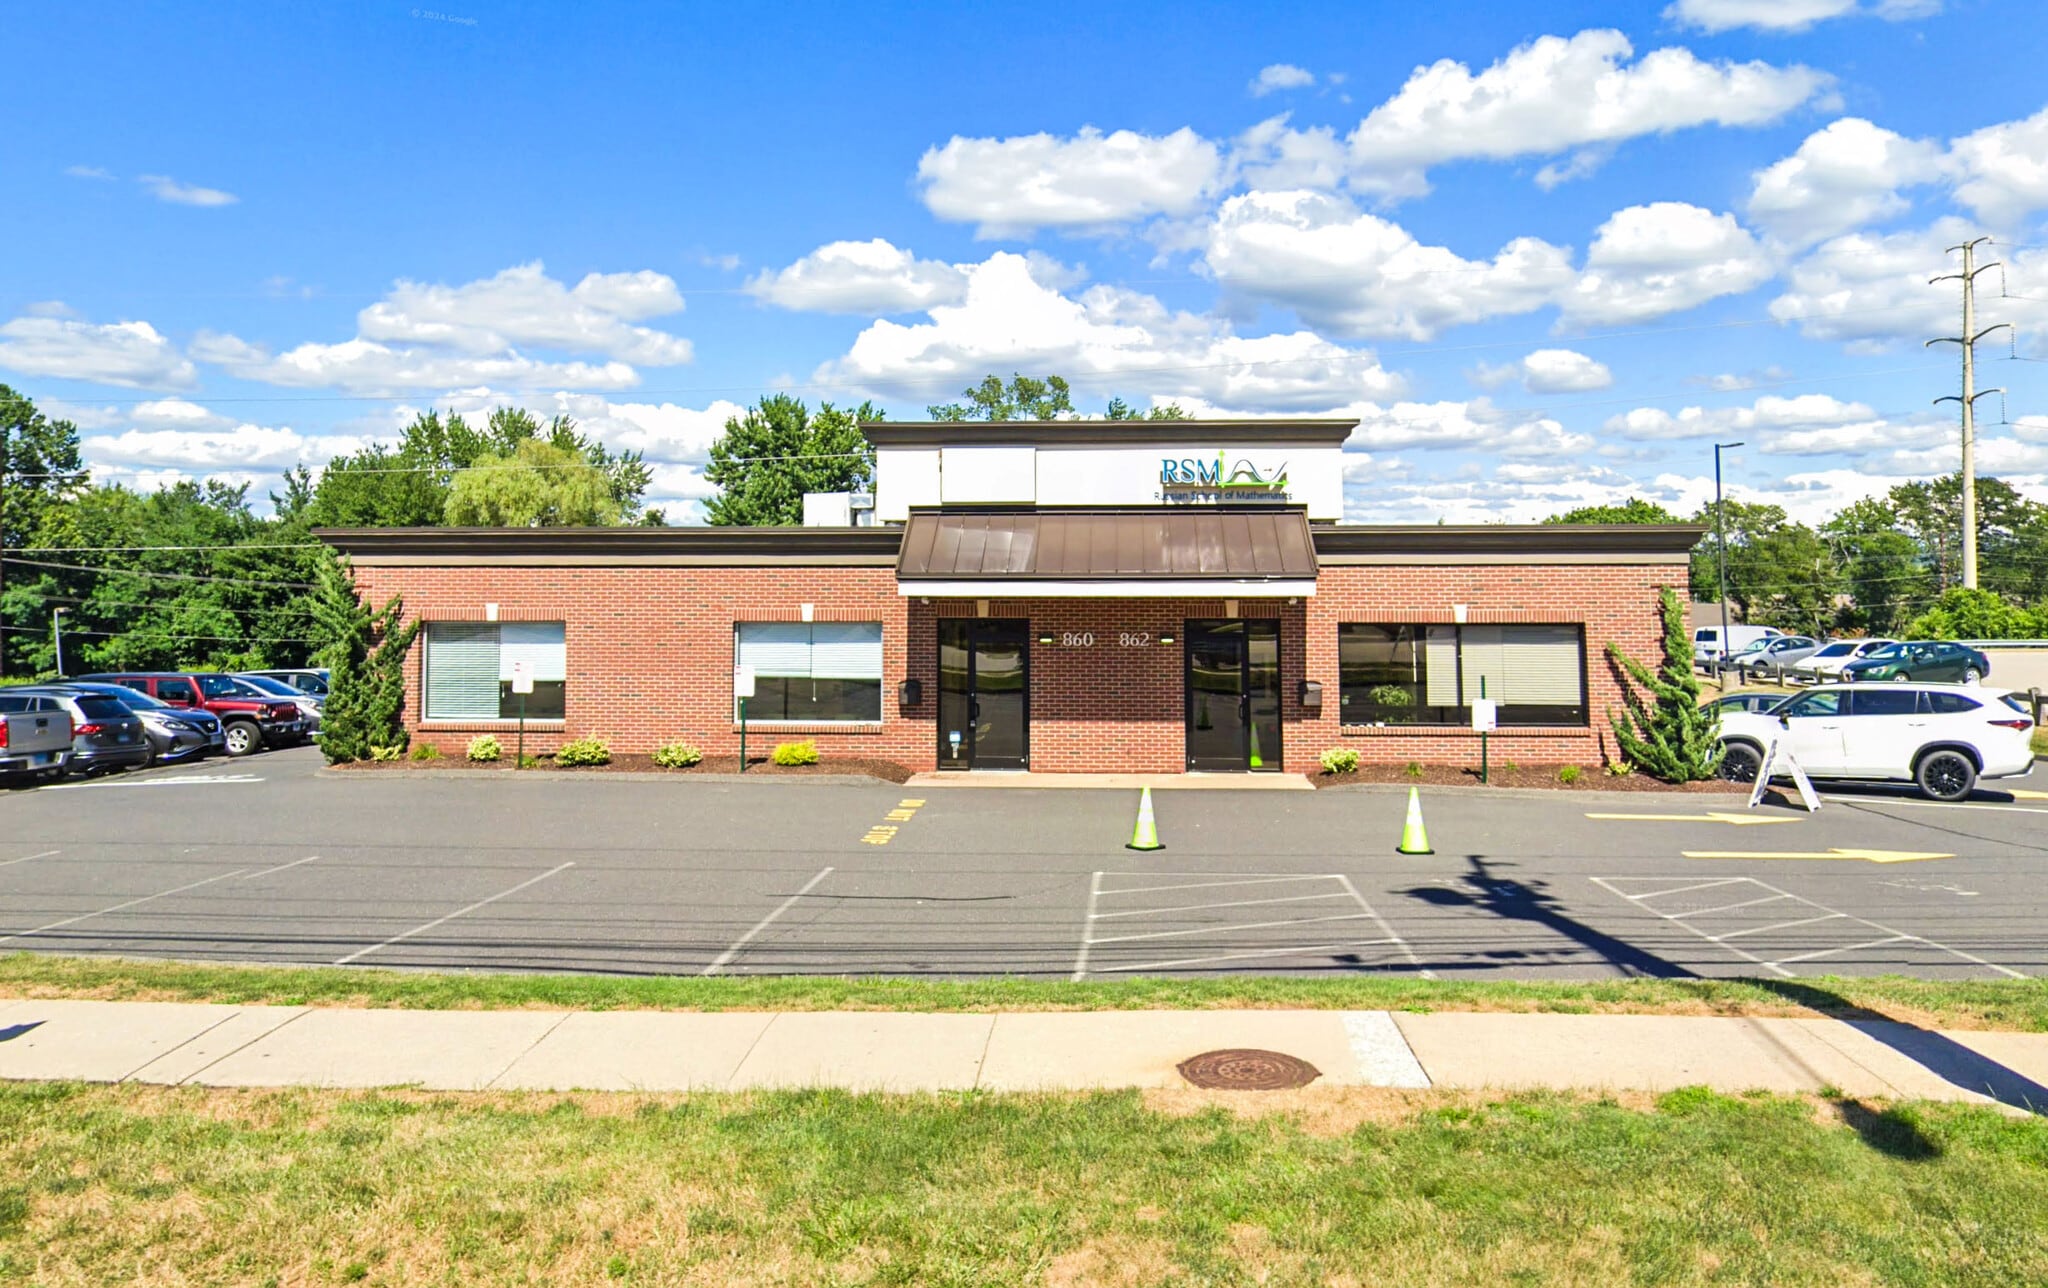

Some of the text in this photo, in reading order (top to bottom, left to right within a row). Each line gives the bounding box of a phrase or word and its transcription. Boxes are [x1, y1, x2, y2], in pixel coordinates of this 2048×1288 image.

[1161, 459, 1220, 482] RSM
[1154, 491, 1292, 501] Rssian School of Mathematics
[1062, 632, 1094, 647] 860
[1119, 632, 1150, 647] 862
